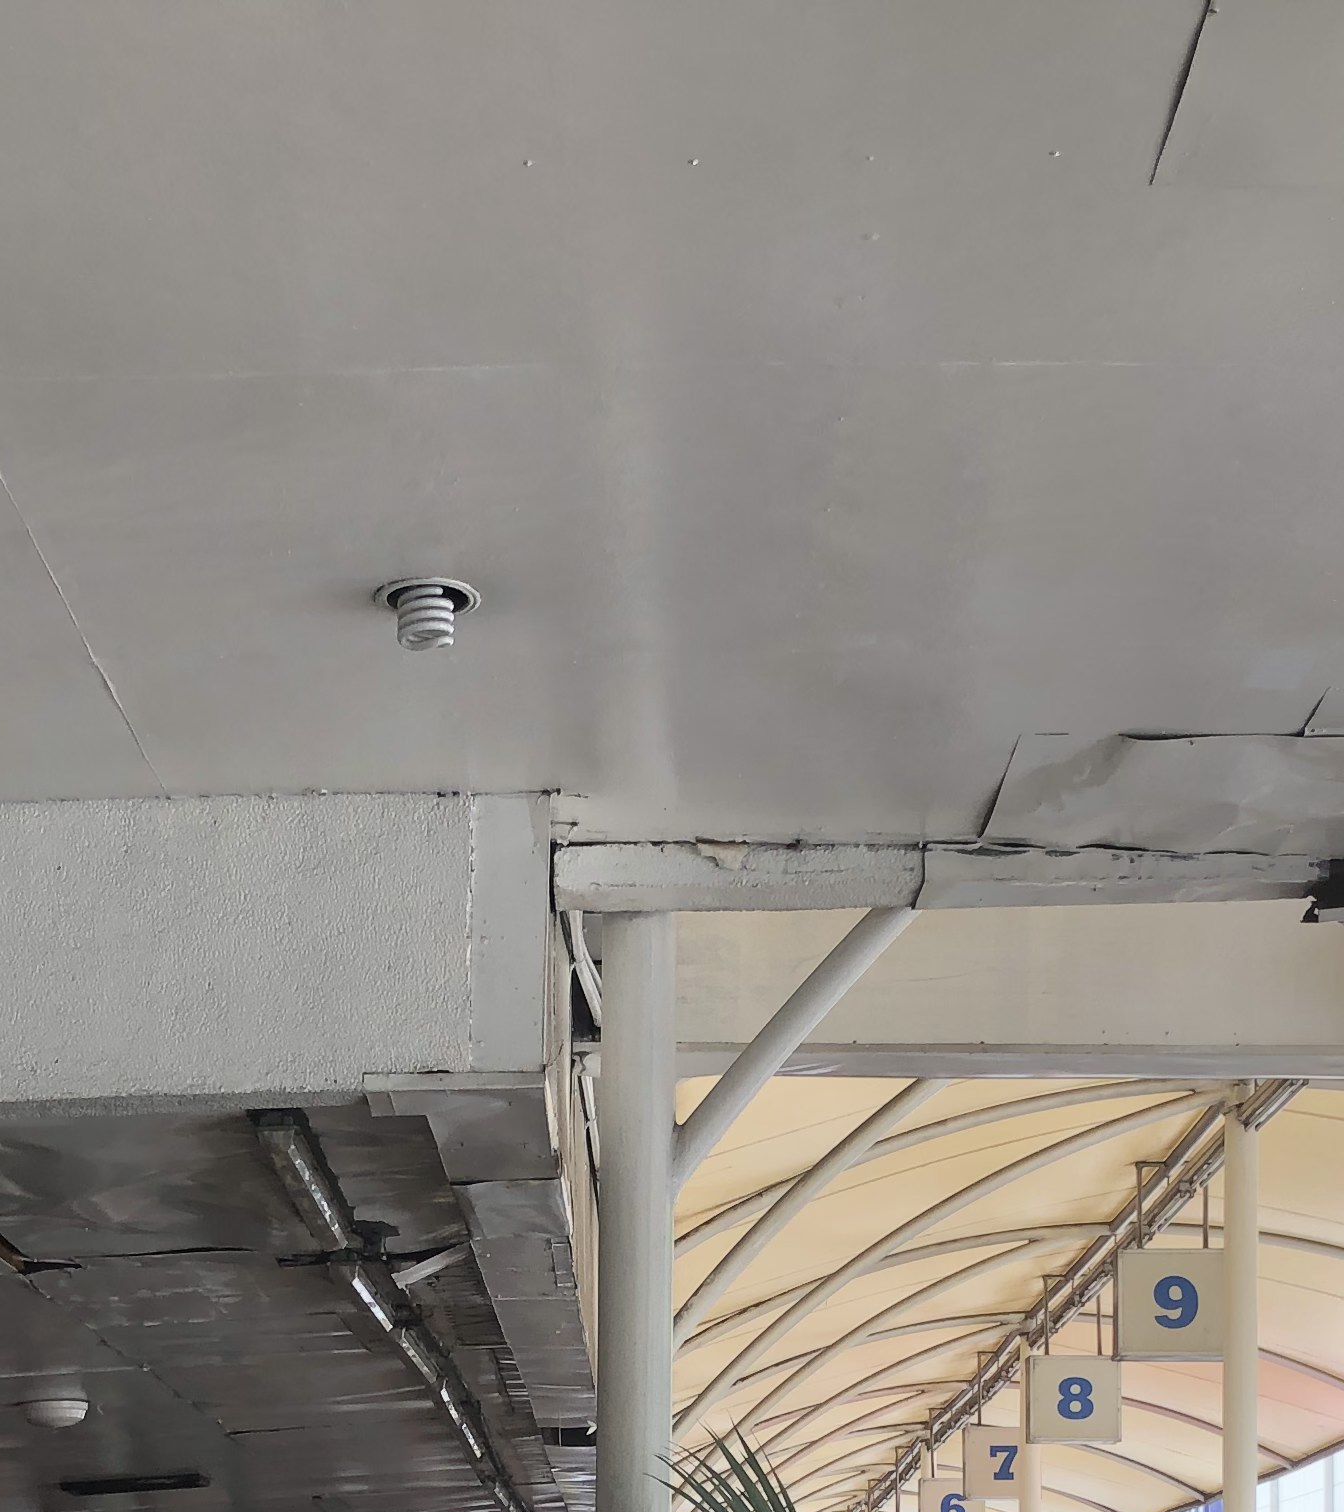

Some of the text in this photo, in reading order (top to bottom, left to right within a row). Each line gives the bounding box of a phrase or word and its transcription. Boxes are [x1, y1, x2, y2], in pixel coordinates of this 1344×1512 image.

[1153, 1275, 1199, 1329] 9
[1057, 1377, 1094, 1420] 8
[989, 1445, 1018, 1481] 7
